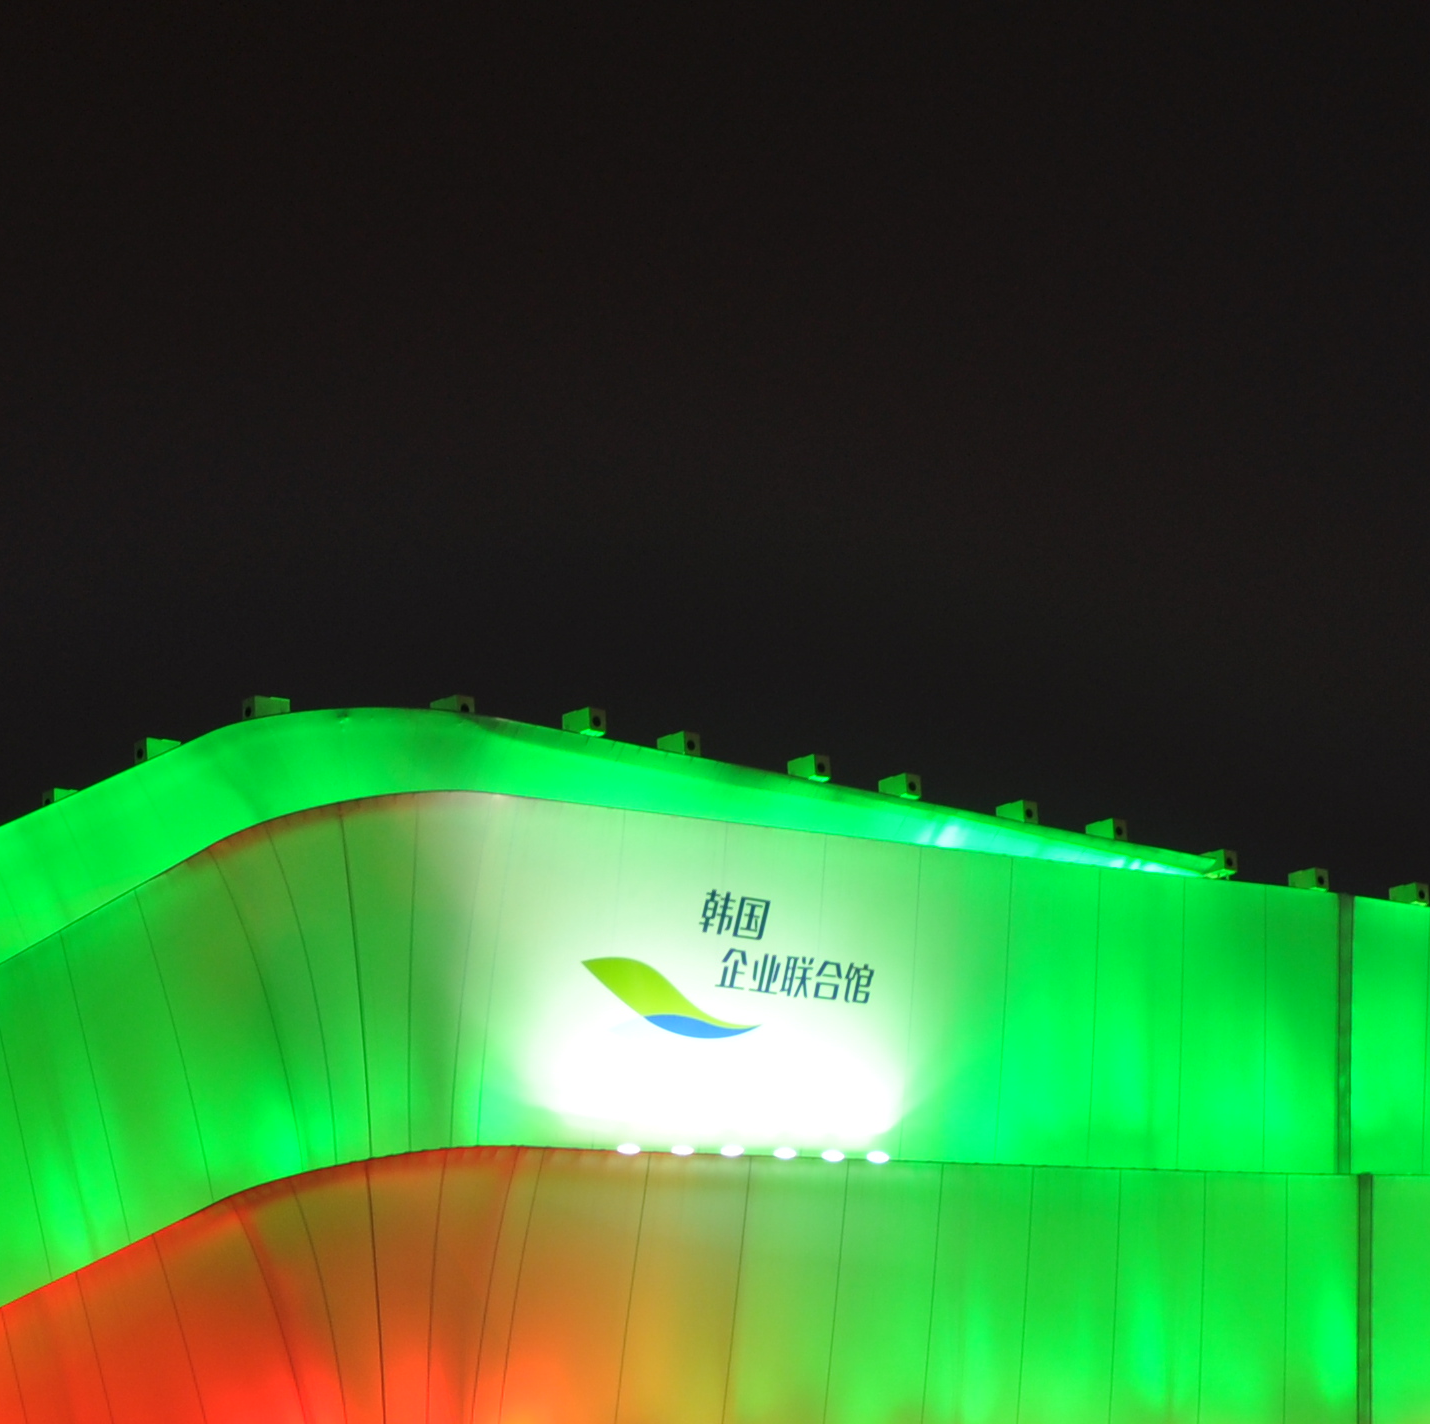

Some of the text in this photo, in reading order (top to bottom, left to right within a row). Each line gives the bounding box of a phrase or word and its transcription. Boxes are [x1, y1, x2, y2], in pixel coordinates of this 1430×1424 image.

[699, 889, 771, 940] 韩国
[715, 948, 875, 1004] 企业联合馆
